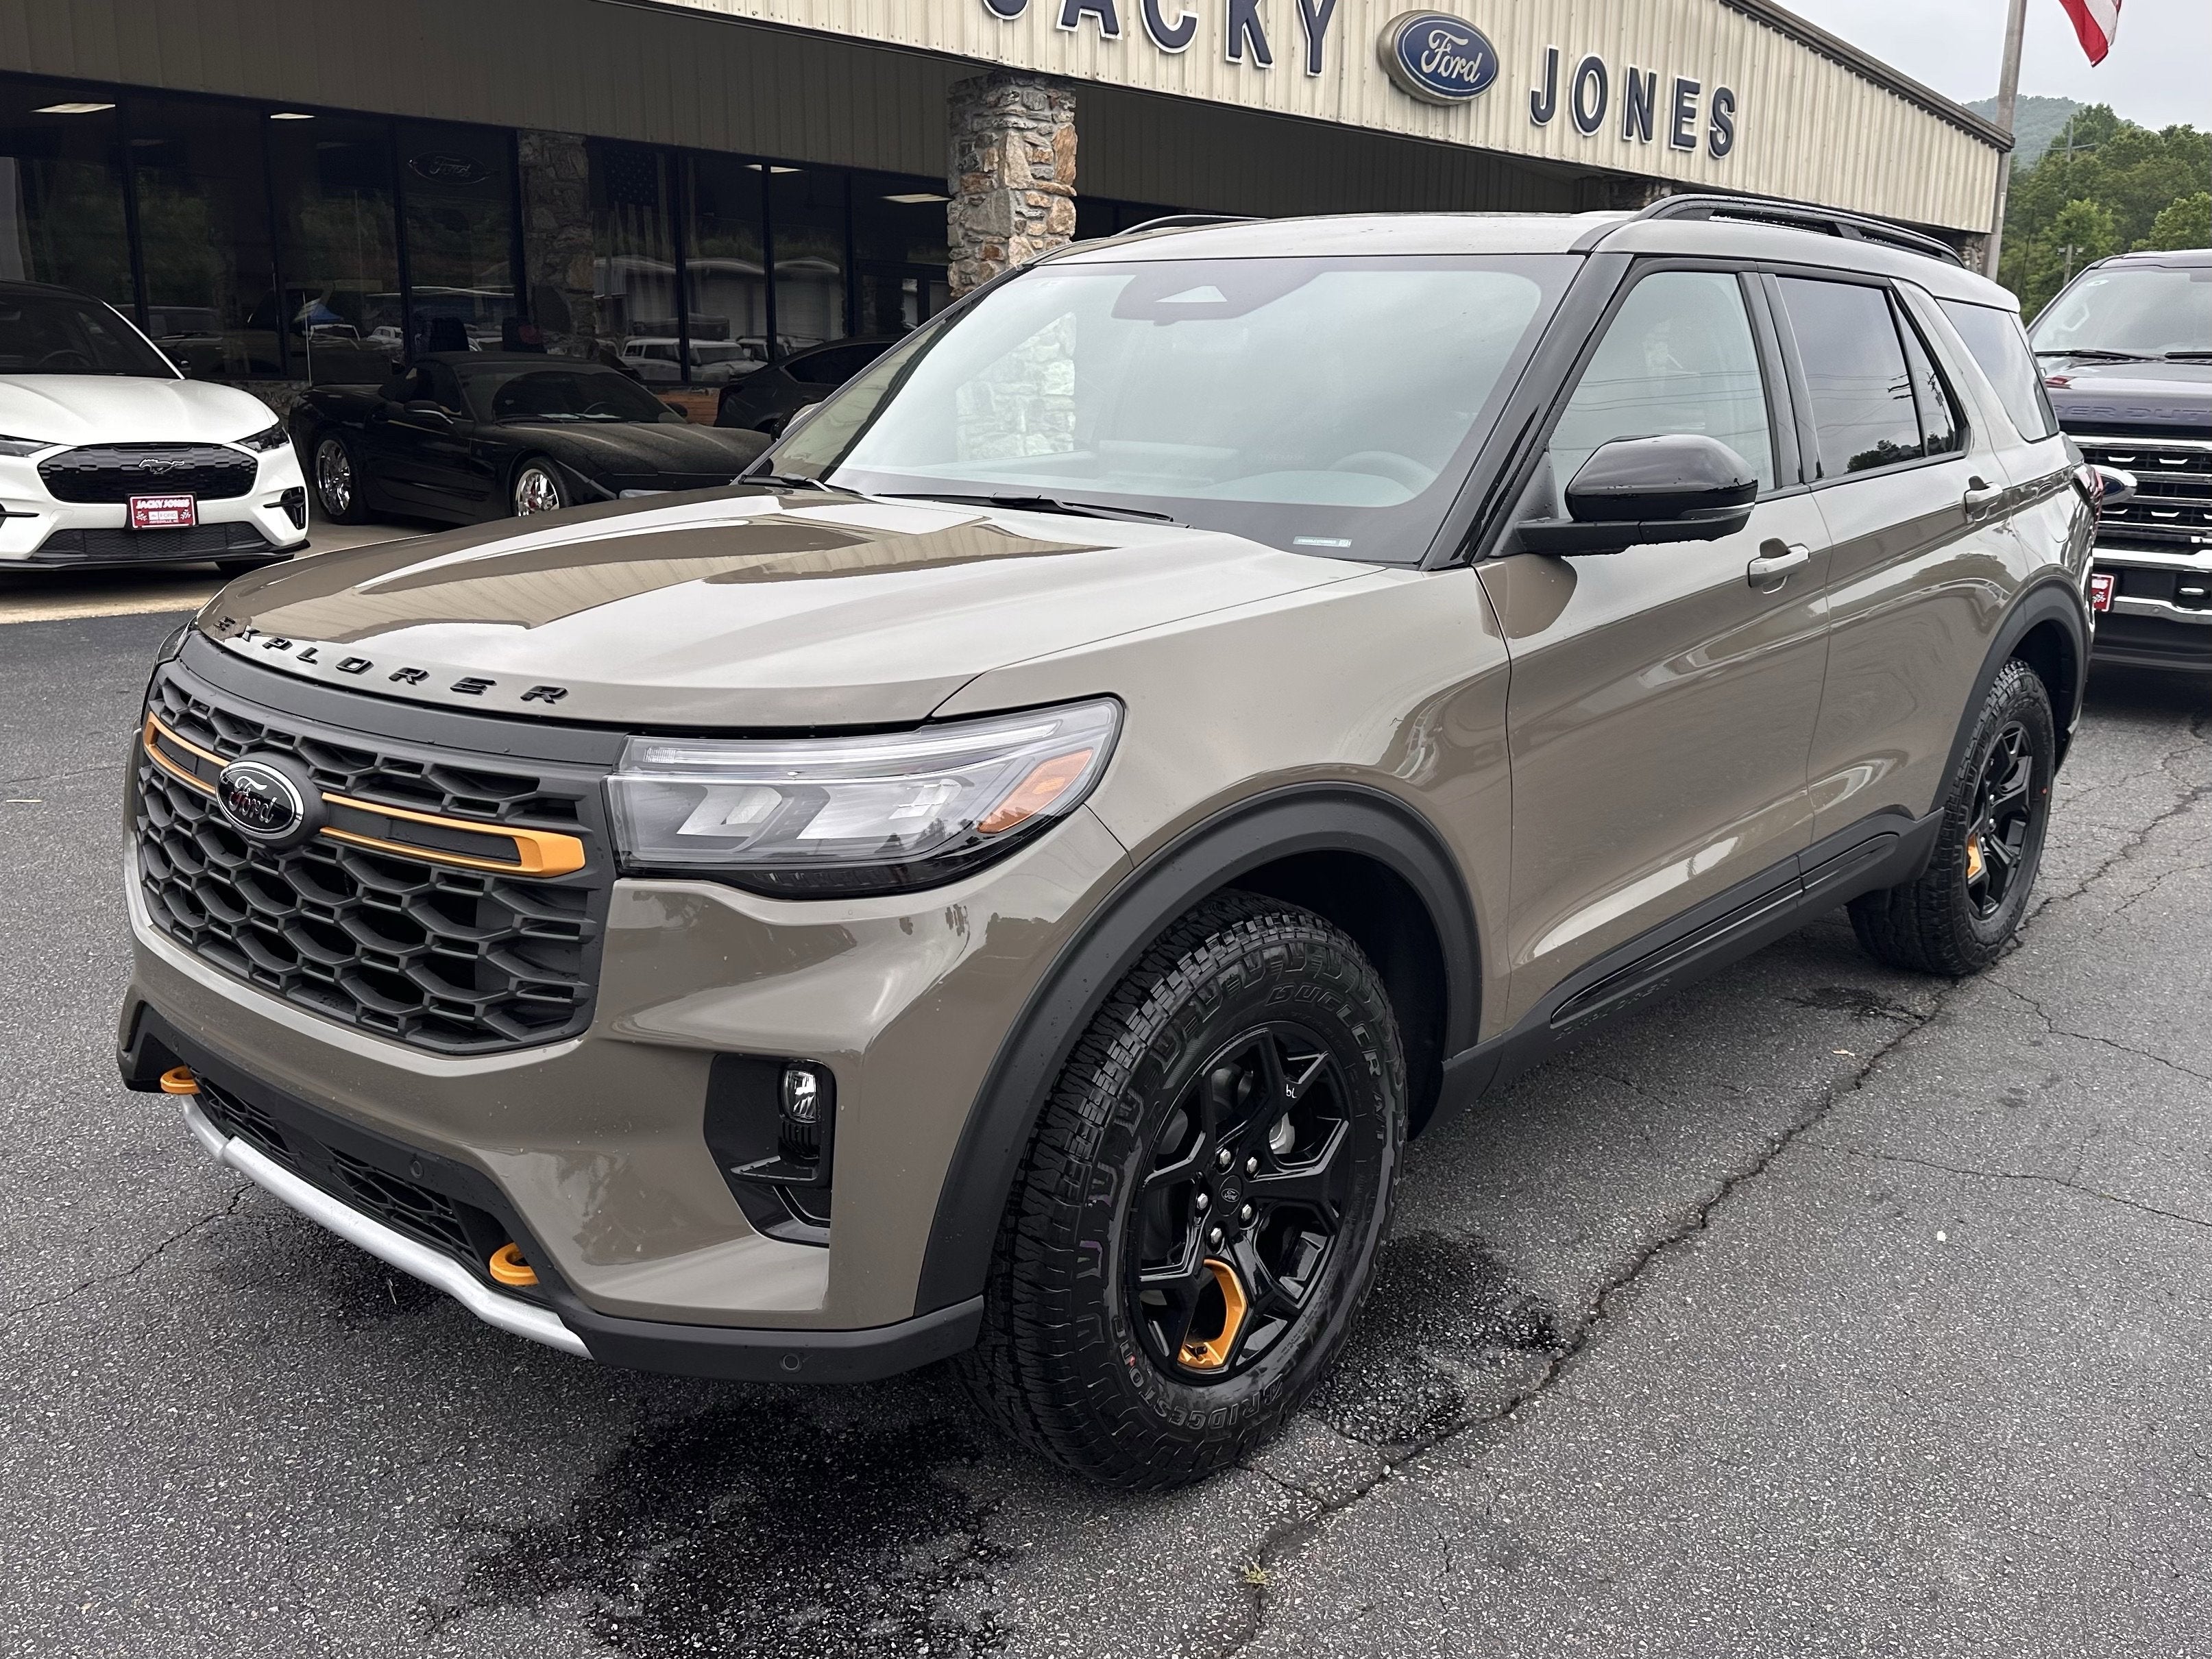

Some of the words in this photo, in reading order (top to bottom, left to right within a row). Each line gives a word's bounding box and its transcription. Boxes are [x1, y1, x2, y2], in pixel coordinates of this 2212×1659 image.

[982, 0, 1338, 77] CKY
[1530, 45, 1736, 159] JONES
[1420, 29, 1483, 84] Ford
[2126, 407, 2212, 422] DUT
[136, 499, 164, 509] JACKY
[162, 498, 190, 509] JONES
[213, 616, 570, 705] EXPLORER
[228, 775, 278, 824] Ford
[1224, 1189, 1238, 1200] Ford
[1111, 1315, 1284, 1430] BRIDGESTONE
